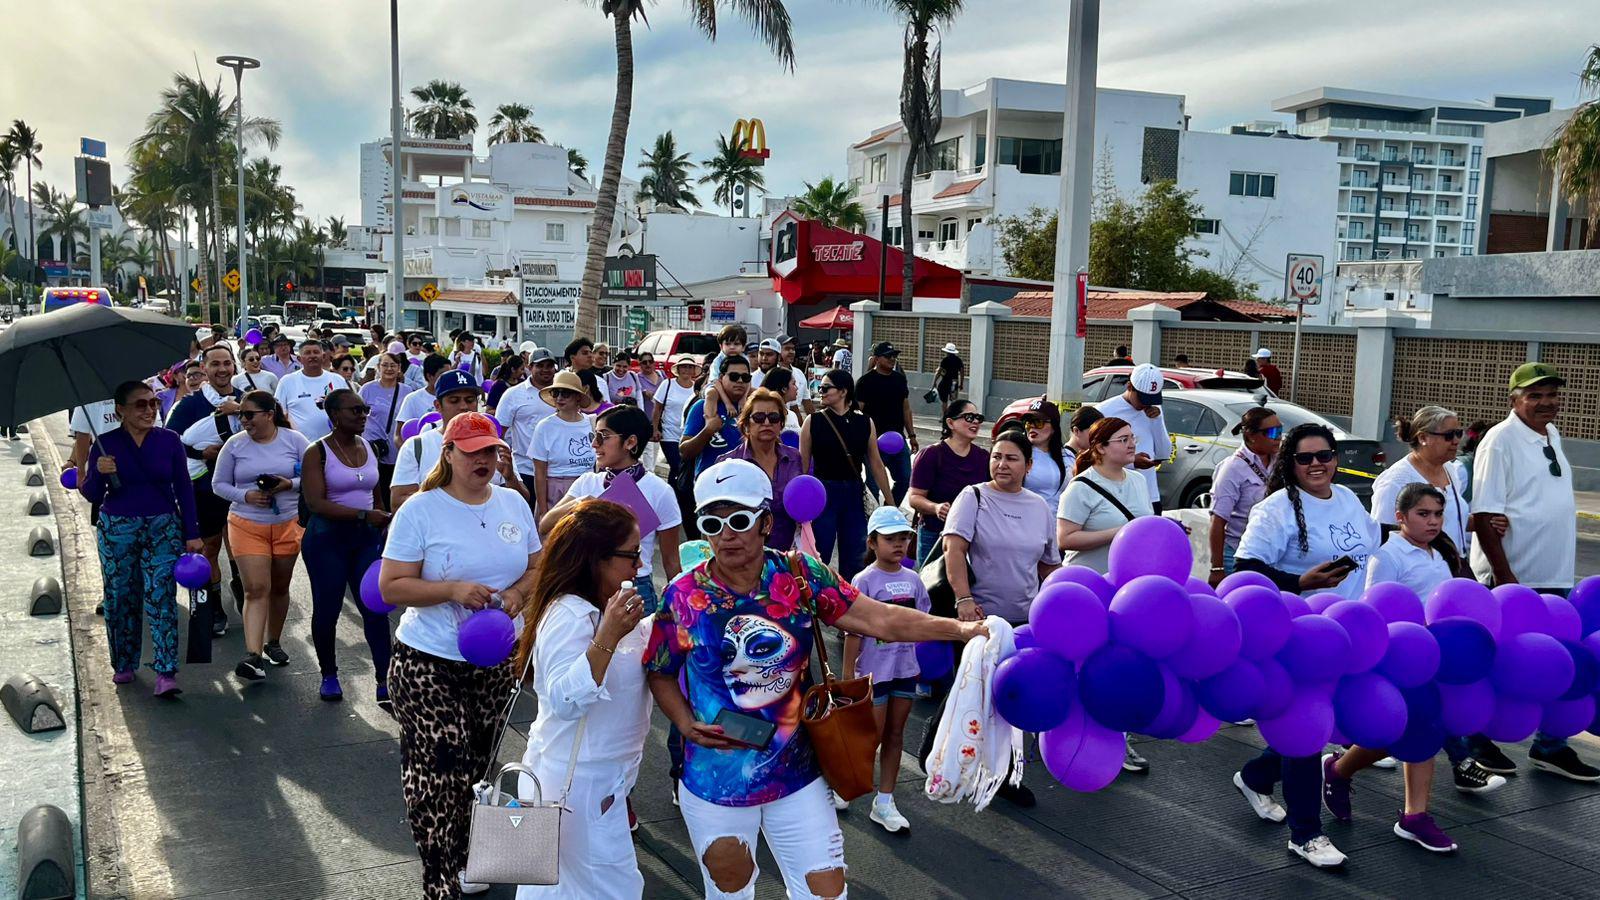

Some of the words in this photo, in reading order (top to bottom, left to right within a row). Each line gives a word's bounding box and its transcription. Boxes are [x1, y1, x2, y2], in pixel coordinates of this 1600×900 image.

[470, 192, 503, 200] VISTAMAR
[812, 241, 864, 262] TECATE
[522, 263, 557, 276] ESTACIONAMIENTO
[1296, 266, 1314, 285] 40
[525, 286, 578, 298] ESTACIONAMIENTO
[525, 310, 545, 323] TARIFA
[546, 310, 560, 323] $100
[561, 311, 575, 323] TIEM
[456, 372, 468, 385] LA
[1150, 381, 1158, 392] B
[568, 456, 594, 465] Renacer
